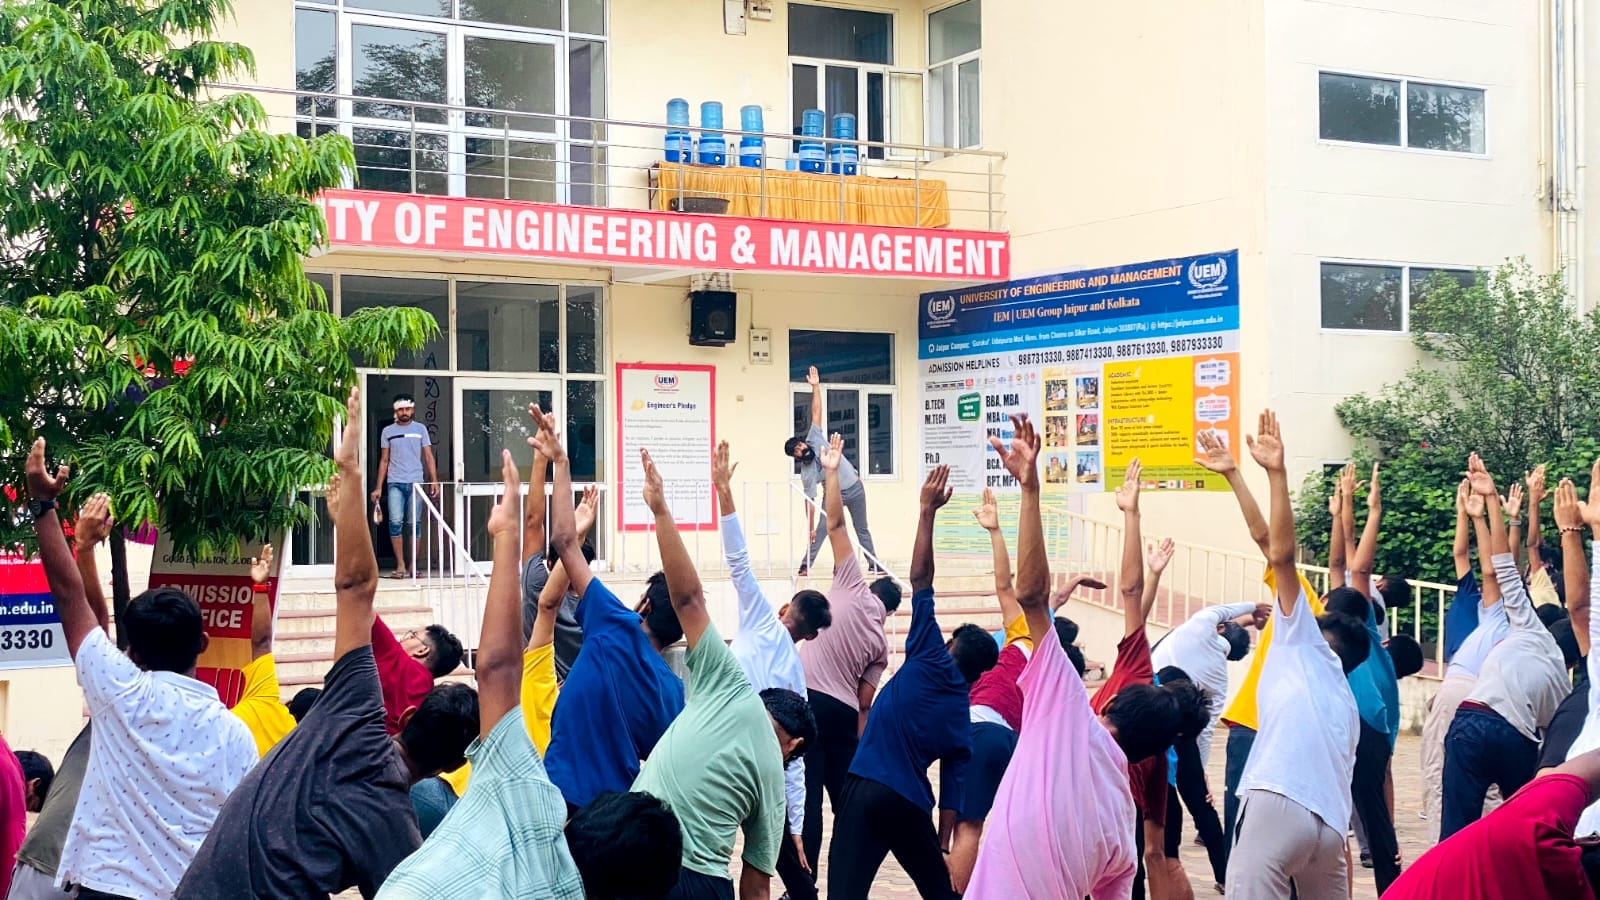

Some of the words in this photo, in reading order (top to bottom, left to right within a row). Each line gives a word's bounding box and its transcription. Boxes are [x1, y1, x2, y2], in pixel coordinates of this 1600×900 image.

[317, 198, 380, 241] TY
[394, 202, 447, 245] OF
[463, 206, 717, 263] ENGINEERING
[730, 225, 756, 264] &
[770, 227, 1005, 276] MANAGEMENT
[1194, 263, 1221, 279] UEM
[960, 288, 1008, 304] UNIVERSITY
[1010, 286, 1022, 298] OF
[1024, 277, 1086, 296] ENGINEERING
[1088, 275, 1108, 288] AND
[1110, 265, 1183, 285] MANAGEMENT
[931, 300, 950, 313] IEM
[993, 310, 1010, 323] IEM
[1016, 307, 1035, 320] UEM
[1037, 305, 1062, 318] Group
[1063, 303, 1088, 317] Jaipur
[1089, 298, 1105, 312] and
[1107, 296, 1140, 309] Kolkata
[928, 361, 964, 374] ADMISSION
[966, 357, 1000, 371] HELPLINES
[1171, 336, 1223, 353] 9887933330
[658, 376, 675, 384] UEM
[647, 401, 676, 410] Engineer's
[677, 402, 697, 411] Pledge
[925, 398, 945, 410] B.TECH
[1003, 393, 1020, 407] MBA
[924, 413, 947, 425] M.TECH
[986, 411, 1000, 423] MBA
[924, 452, 940, 464] Ph.D
[160, 584, 255, 605] MISSIO
[200, 609, 243, 629] FICE
[1, 629, 53, 650] 3330
